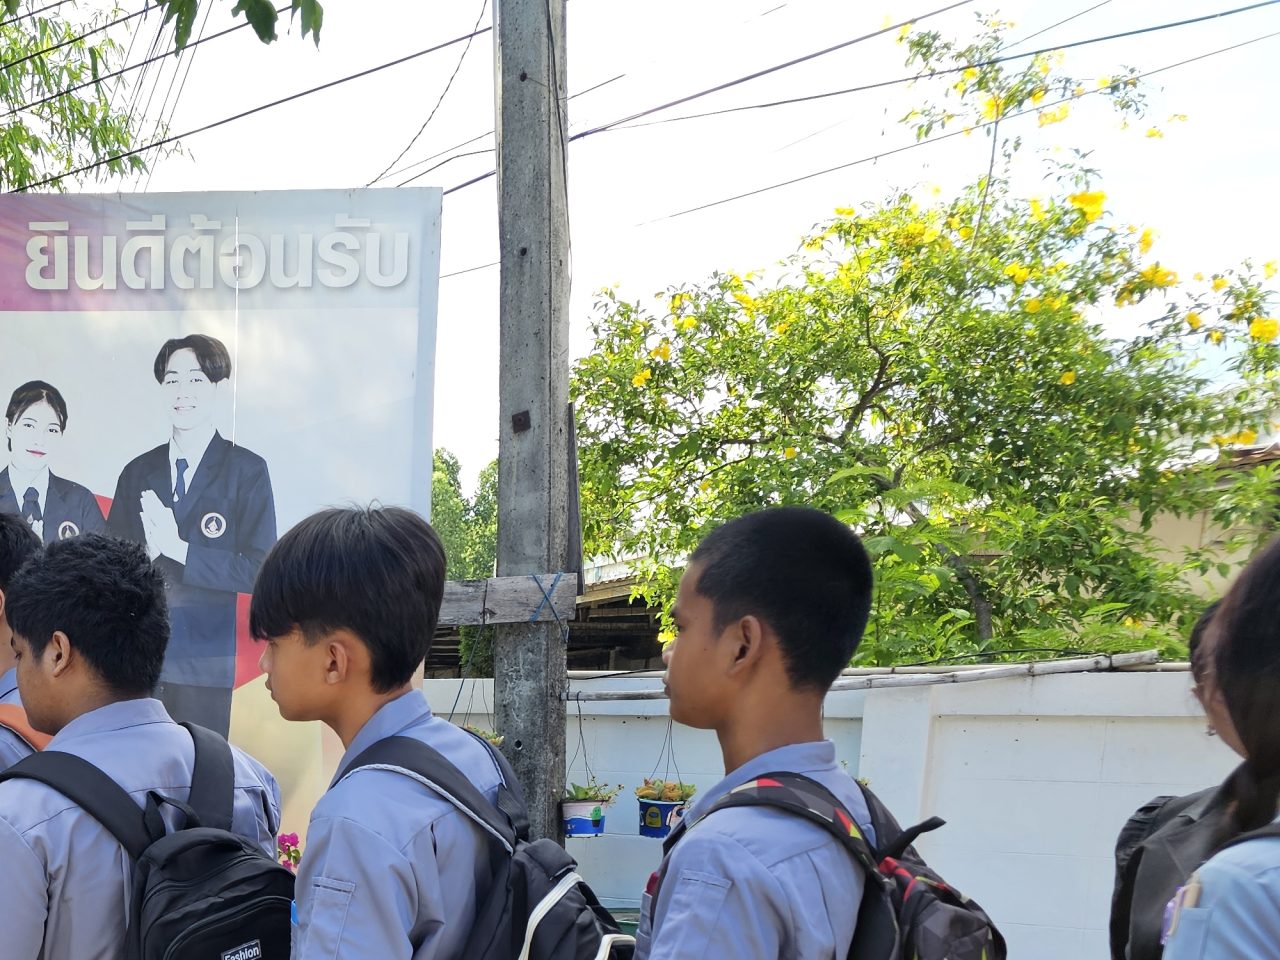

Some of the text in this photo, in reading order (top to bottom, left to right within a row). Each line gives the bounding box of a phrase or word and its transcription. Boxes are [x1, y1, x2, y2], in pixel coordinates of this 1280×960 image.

[25, 213, 409, 290] ยินดีต้อนรับ
